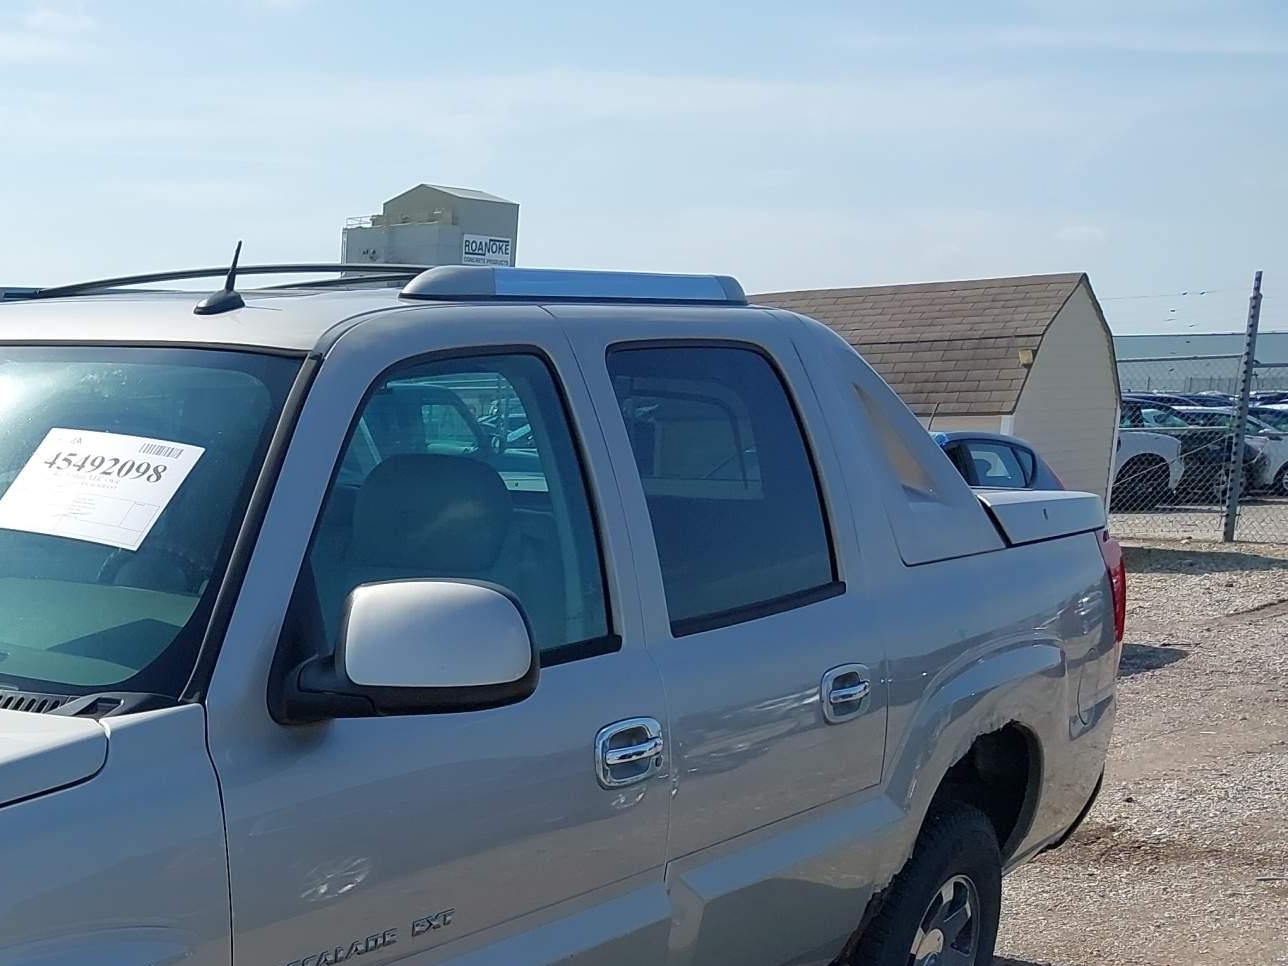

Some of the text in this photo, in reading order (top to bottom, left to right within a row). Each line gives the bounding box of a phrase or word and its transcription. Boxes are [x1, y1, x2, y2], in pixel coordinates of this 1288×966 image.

[464, 239, 510, 256] ROANOKE
[44, 451, 168, 484] 45492098
[410, 907, 456, 938] EXT
